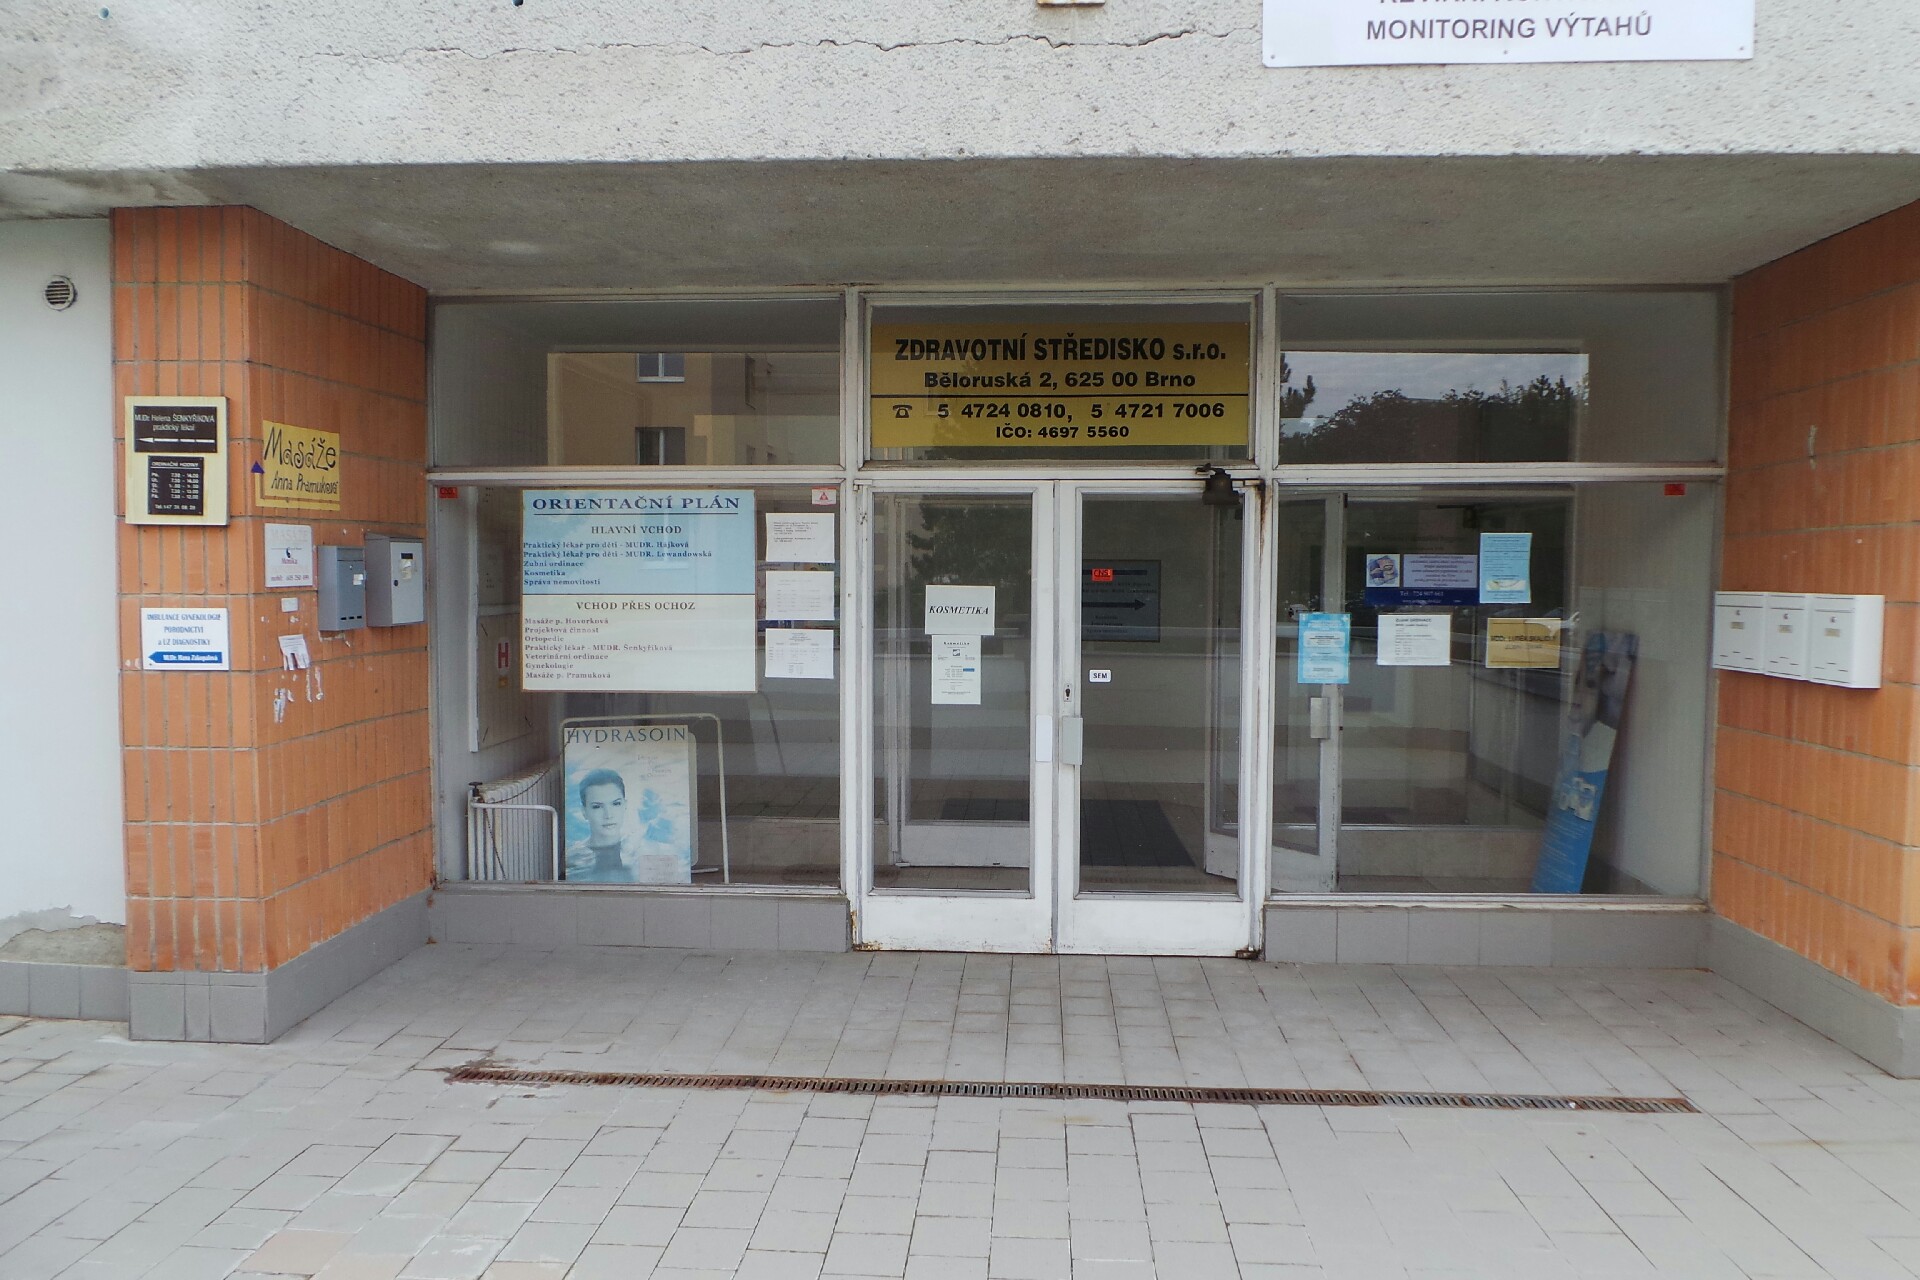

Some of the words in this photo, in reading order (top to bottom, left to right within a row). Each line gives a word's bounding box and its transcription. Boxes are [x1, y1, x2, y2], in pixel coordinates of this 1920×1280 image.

[1367, 18, 1536, 40] MONITORING
[1545, 10, 1652, 38] VÝTAHŮ
[895, 333, 1026, 361] ZDRAVOTNÍ
[1034, 333, 1165, 361] STŘEDISKO
[1172, 342, 1226, 360] s.r.o.
[924, 371, 1031, 388] Běloruská
[1039, 372, 1058, 391] 2,
[1065, 371, 1104, 388] 625
[1111, 371, 1138, 387] 00
[1145, 371, 1196, 387] Brno
[937, 403, 950, 418] 5
[961, 403, 1010, 418] 4724
[1017, 403, 1073, 423] 0810,
[1091, 403, 1103, 418] 5
[1114, 402, 1164, 418] 4721
[1173, 402, 1225, 418] 7006
[996, 422, 1032, 439] IČO:
[1037, 426, 1079, 439] 4697
[1086, 426, 1130, 438] 5560
[263, 426, 337, 471] Masáže
[271, 470, 293, 491] Anna
[296, 473, 339, 495] Pramuková
[532, 495, 674, 510] ORIENTAČNÍ
[681, 495, 741, 509] PLÁN
[591, 524, 637, 535] HLAVNÍ
[640, 525, 682, 534] VCHOD
[523, 541, 561, 550] Praktický
[523, 550, 561, 559] Praktický
[524, 569, 566, 577] Kosmetika
[576, 601, 618, 610] VCHOD
[622, 600, 651, 610] PŘES
[654, 601, 696, 610] OCHOZ
[928, 605, 989, 615] KOSMETIKA
[524, 635, 565, 644] Ortopedie
[497, 642, 509, 669] H
[525, 671, 554, 679] Masáže
[566, 727, 686, 744] HYDRASOIN
